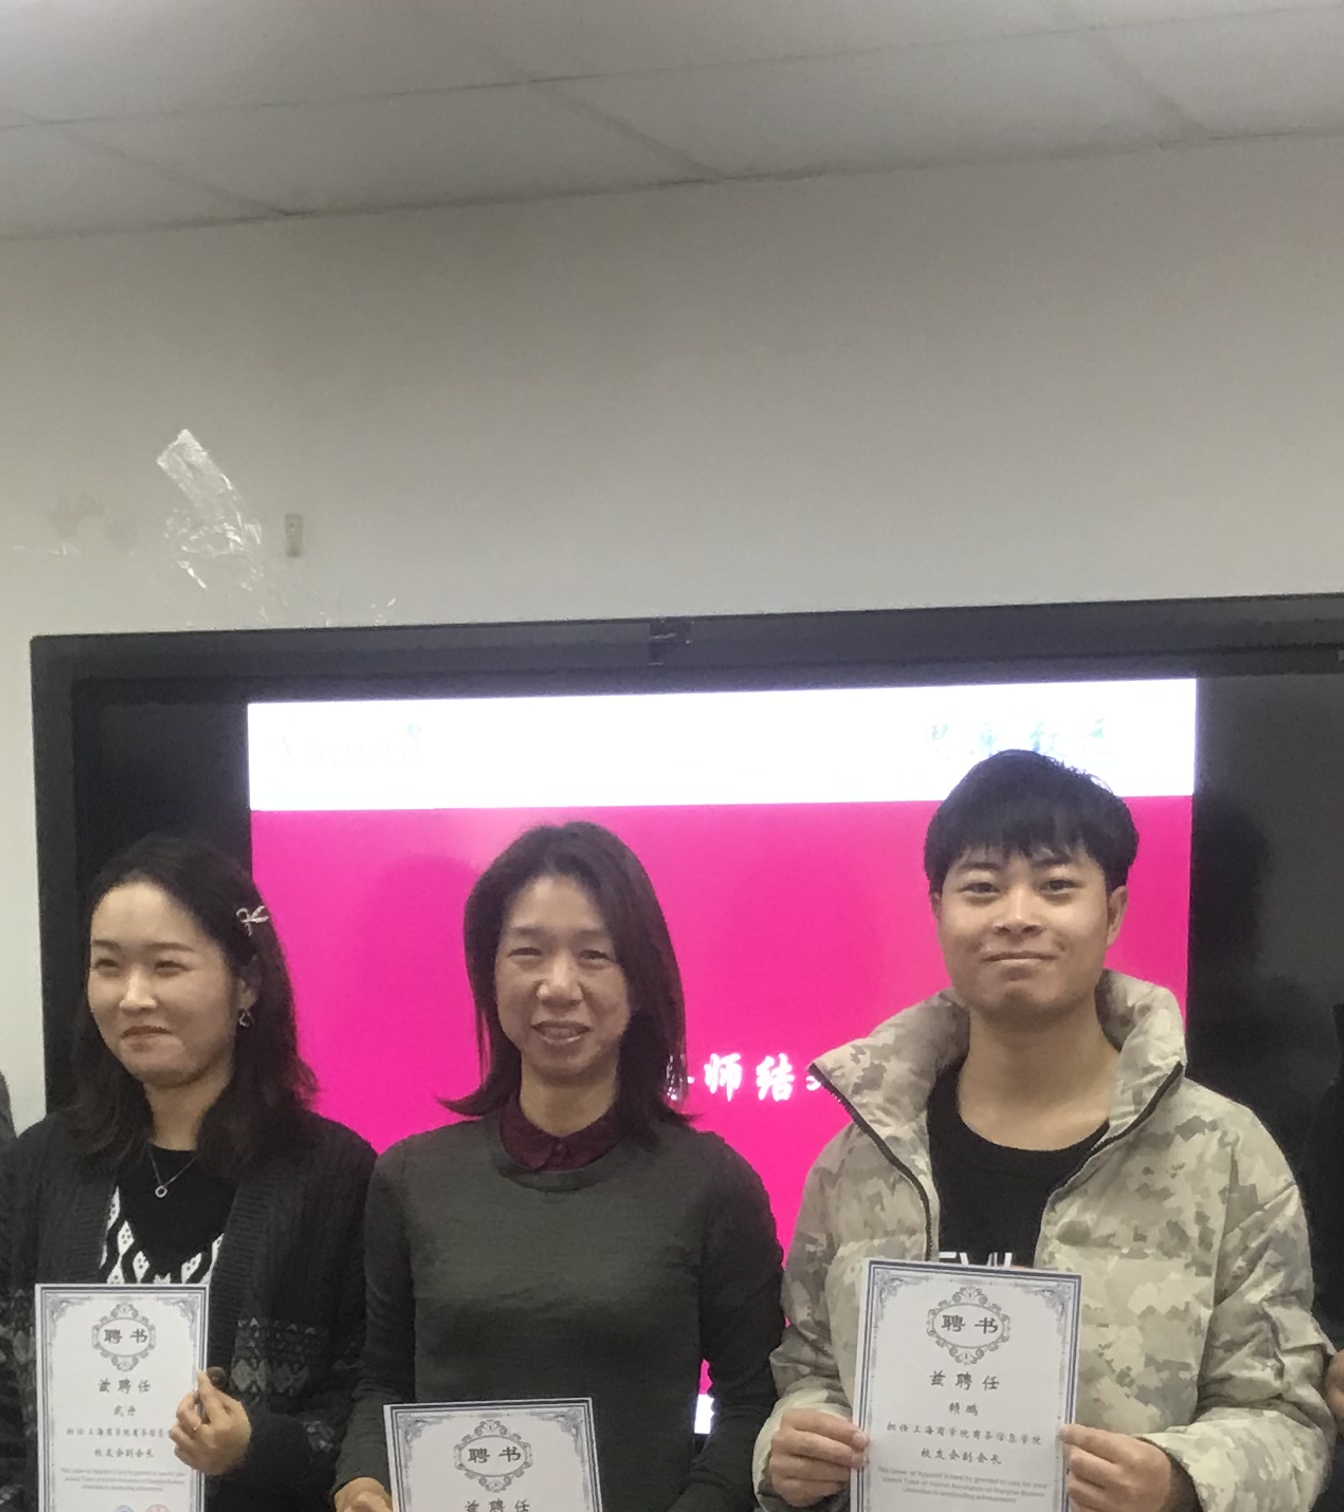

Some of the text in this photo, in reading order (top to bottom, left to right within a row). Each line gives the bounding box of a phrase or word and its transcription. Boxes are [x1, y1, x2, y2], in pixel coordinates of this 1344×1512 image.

[941, 1314, 999, 1334] 聘书
[103, 1328, 148, 1345] 聘书
[98, 1378, 151, 1394] 兹聘任
[929, 1370, 1000, 1391] 兹聘任
[467, 1446, 522, 1463] 聘书
